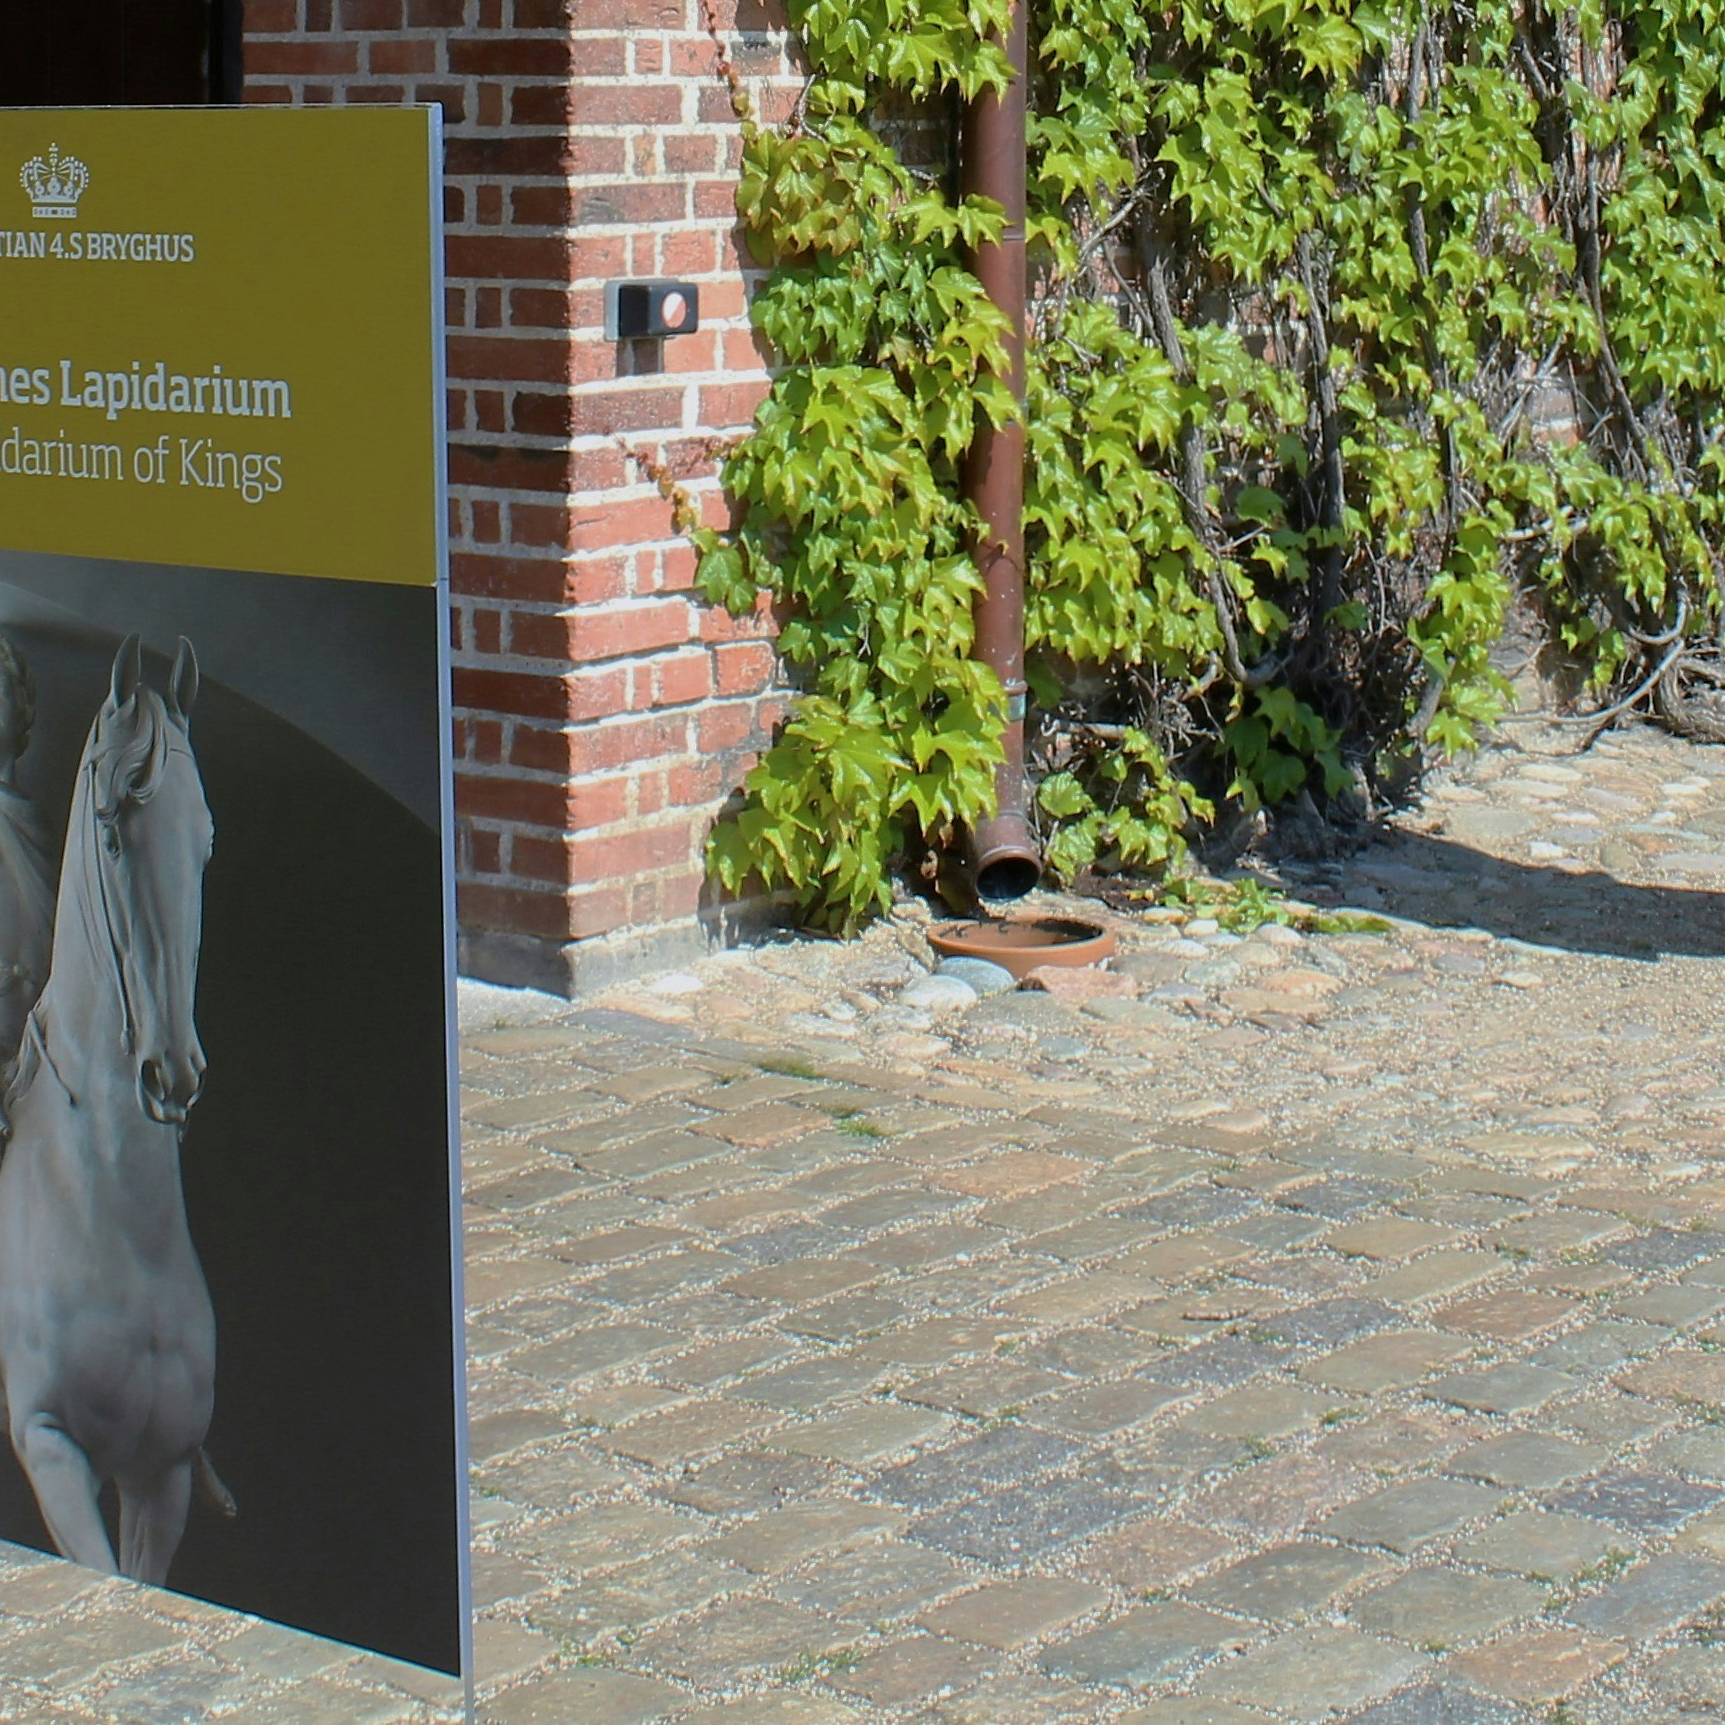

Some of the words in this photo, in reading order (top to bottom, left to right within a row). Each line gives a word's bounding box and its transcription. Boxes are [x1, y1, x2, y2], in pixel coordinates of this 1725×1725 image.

[49, 232, 84, 260] 4.S
[86, 232, 195, 263] BRYGHUS
[59, 359, 292, 421] Lapidarium
[133, 434, 170, 484] of
[179, 438, 283, 503] Kings
